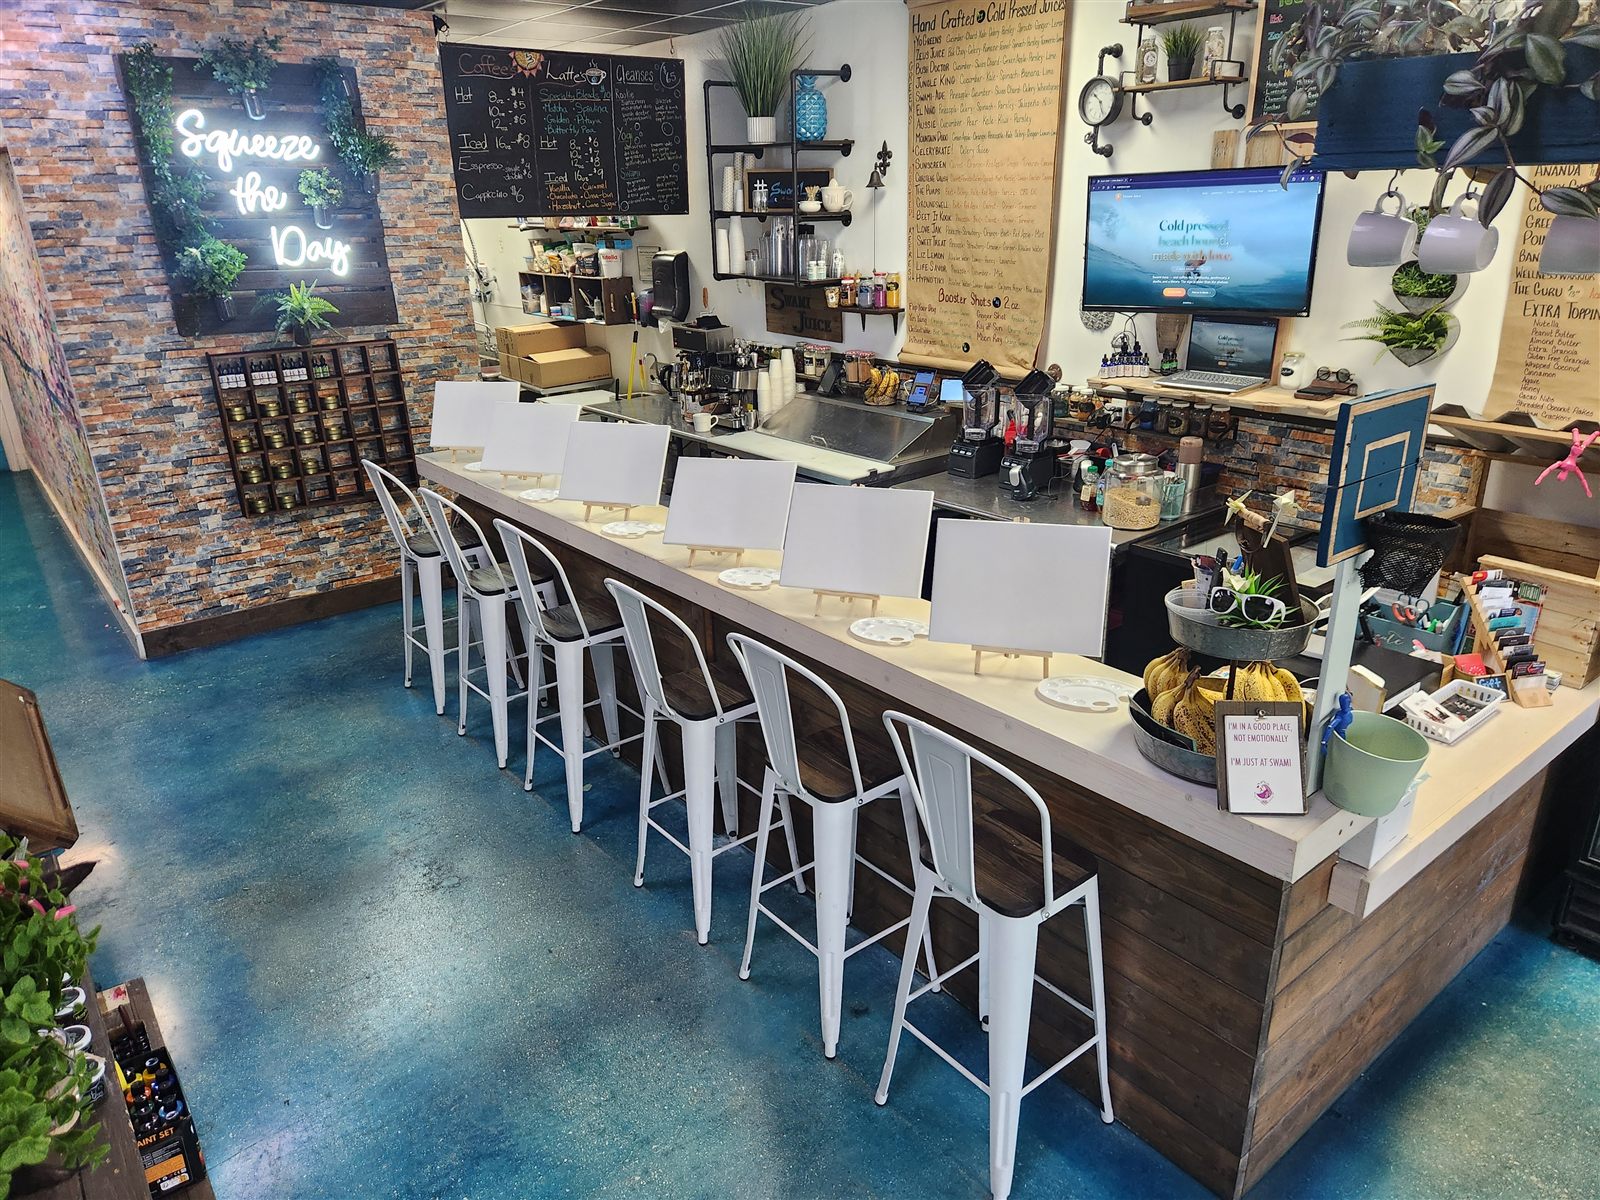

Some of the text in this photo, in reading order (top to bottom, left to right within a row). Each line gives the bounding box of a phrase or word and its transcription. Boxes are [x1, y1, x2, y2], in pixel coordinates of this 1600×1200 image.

[912, 13, 937, 33] Hand
[941, 8, 976, 30] Crafted
[987, 1, 1007, 22] Cold
[1008, 0, 1037, 20] Pressed
[546, 59, 587, 83] Latte's
[616, 64, 654, 84] Cleanses
[915, 76, 938, 89] JUNGLE
[455, 86, 473, 102] Hot
[513, 113, 527, 125] $6
[915, 118, 937, 130] AUSSIE
[176, 108, 321, 172] Squeeze
[458, 132, 488, 150] Iced
[540, 135, 558, 148] Hot
[543, 171, 569, 184] Iced
[230, 170, 288, 216] the
[1159, 219, 1185, 232] Cold
[270, 224, 352, 277] Day
[1512, 280, 1531, 295] THE
[1533, 281, 1563, 298] GURU
[938, 286, 967, 305] Booster
[970, 291, 992, 307] Shots
[1003, 295, 1010, 310] 2
[1522, 299, 1561, 319] EXTRA
[793, 310, 833, 334] JUICE
[1533, 318, 1560, 328] Nutella
[1228, 722, 1293, 732] I'M IN A GOOD PLACE,
[1233, 734, 1289, 743] NOT EMOTIONALLY
[1230, 757, 1292, 767] I'M JUST AT SWAMI
[137, 1126, 175, 1148] AINT SET
